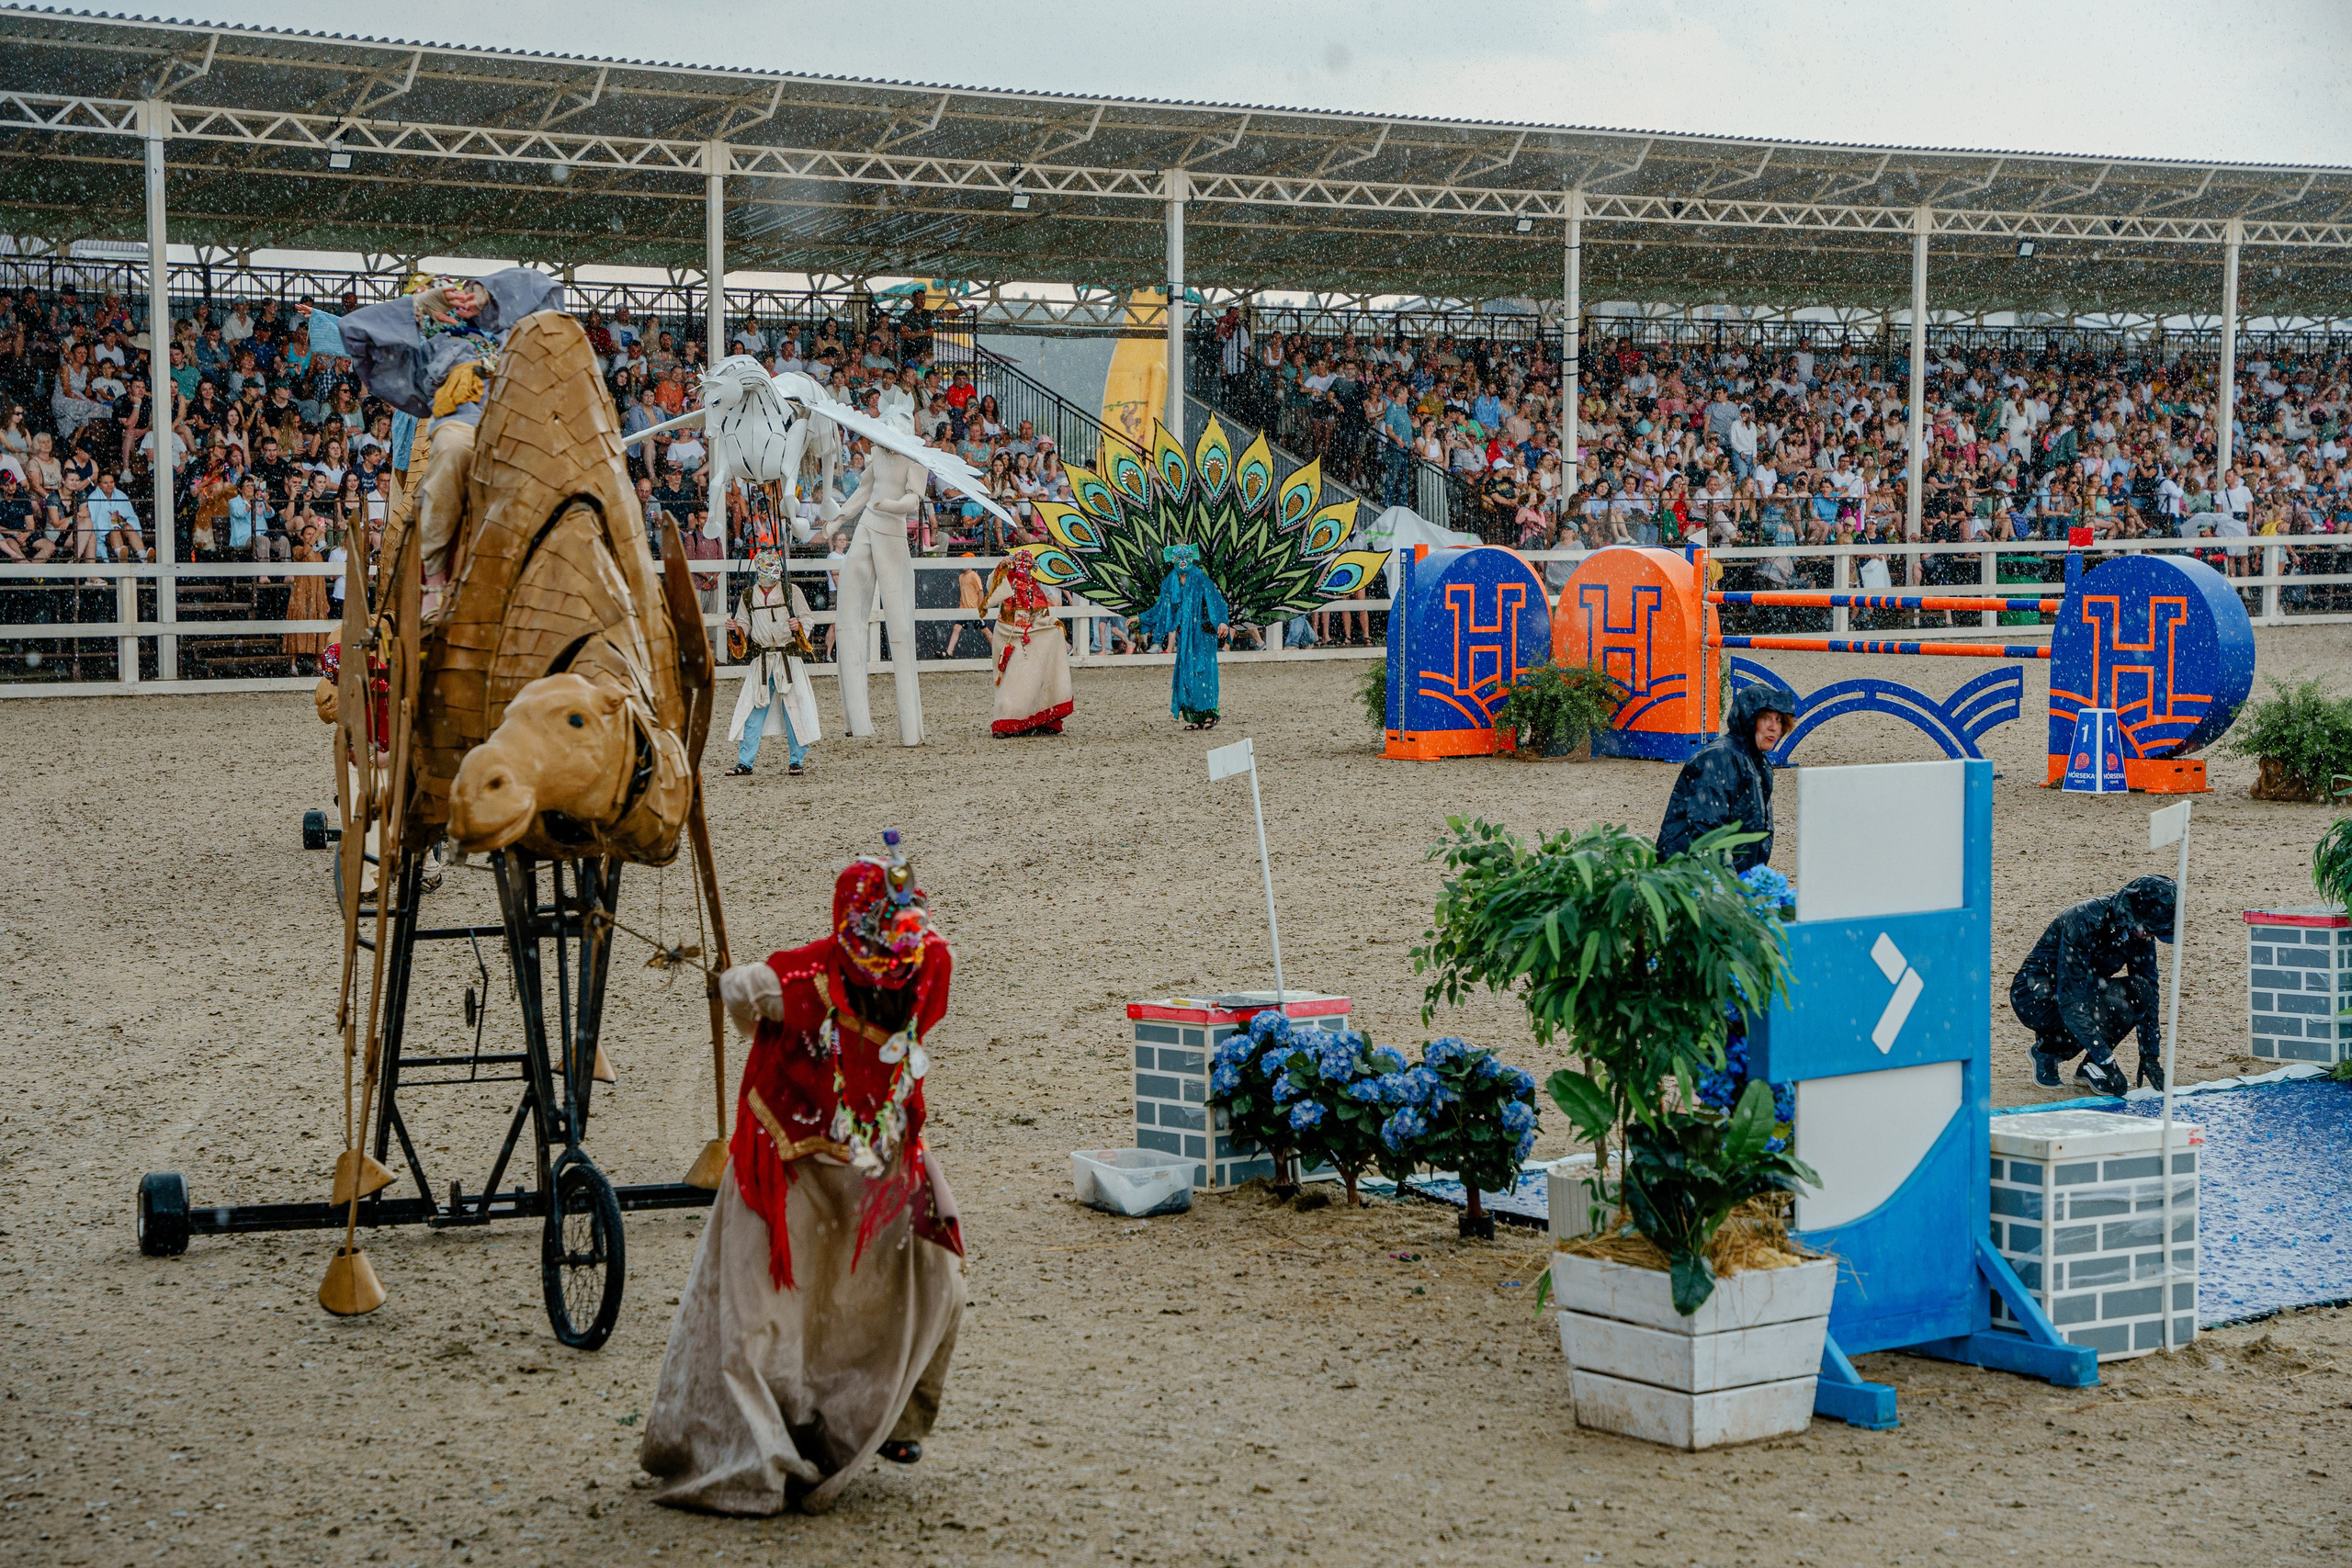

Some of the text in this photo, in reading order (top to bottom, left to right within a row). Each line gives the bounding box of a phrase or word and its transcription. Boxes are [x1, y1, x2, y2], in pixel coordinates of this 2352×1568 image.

[1445, 582, 1527, 696] H
[1578, 583, 1662, 697] H
[2082, 595, 2188, 720] H
[2081, 724, 2089, 743] 1
[2107, 725, 2114, 743] 1
